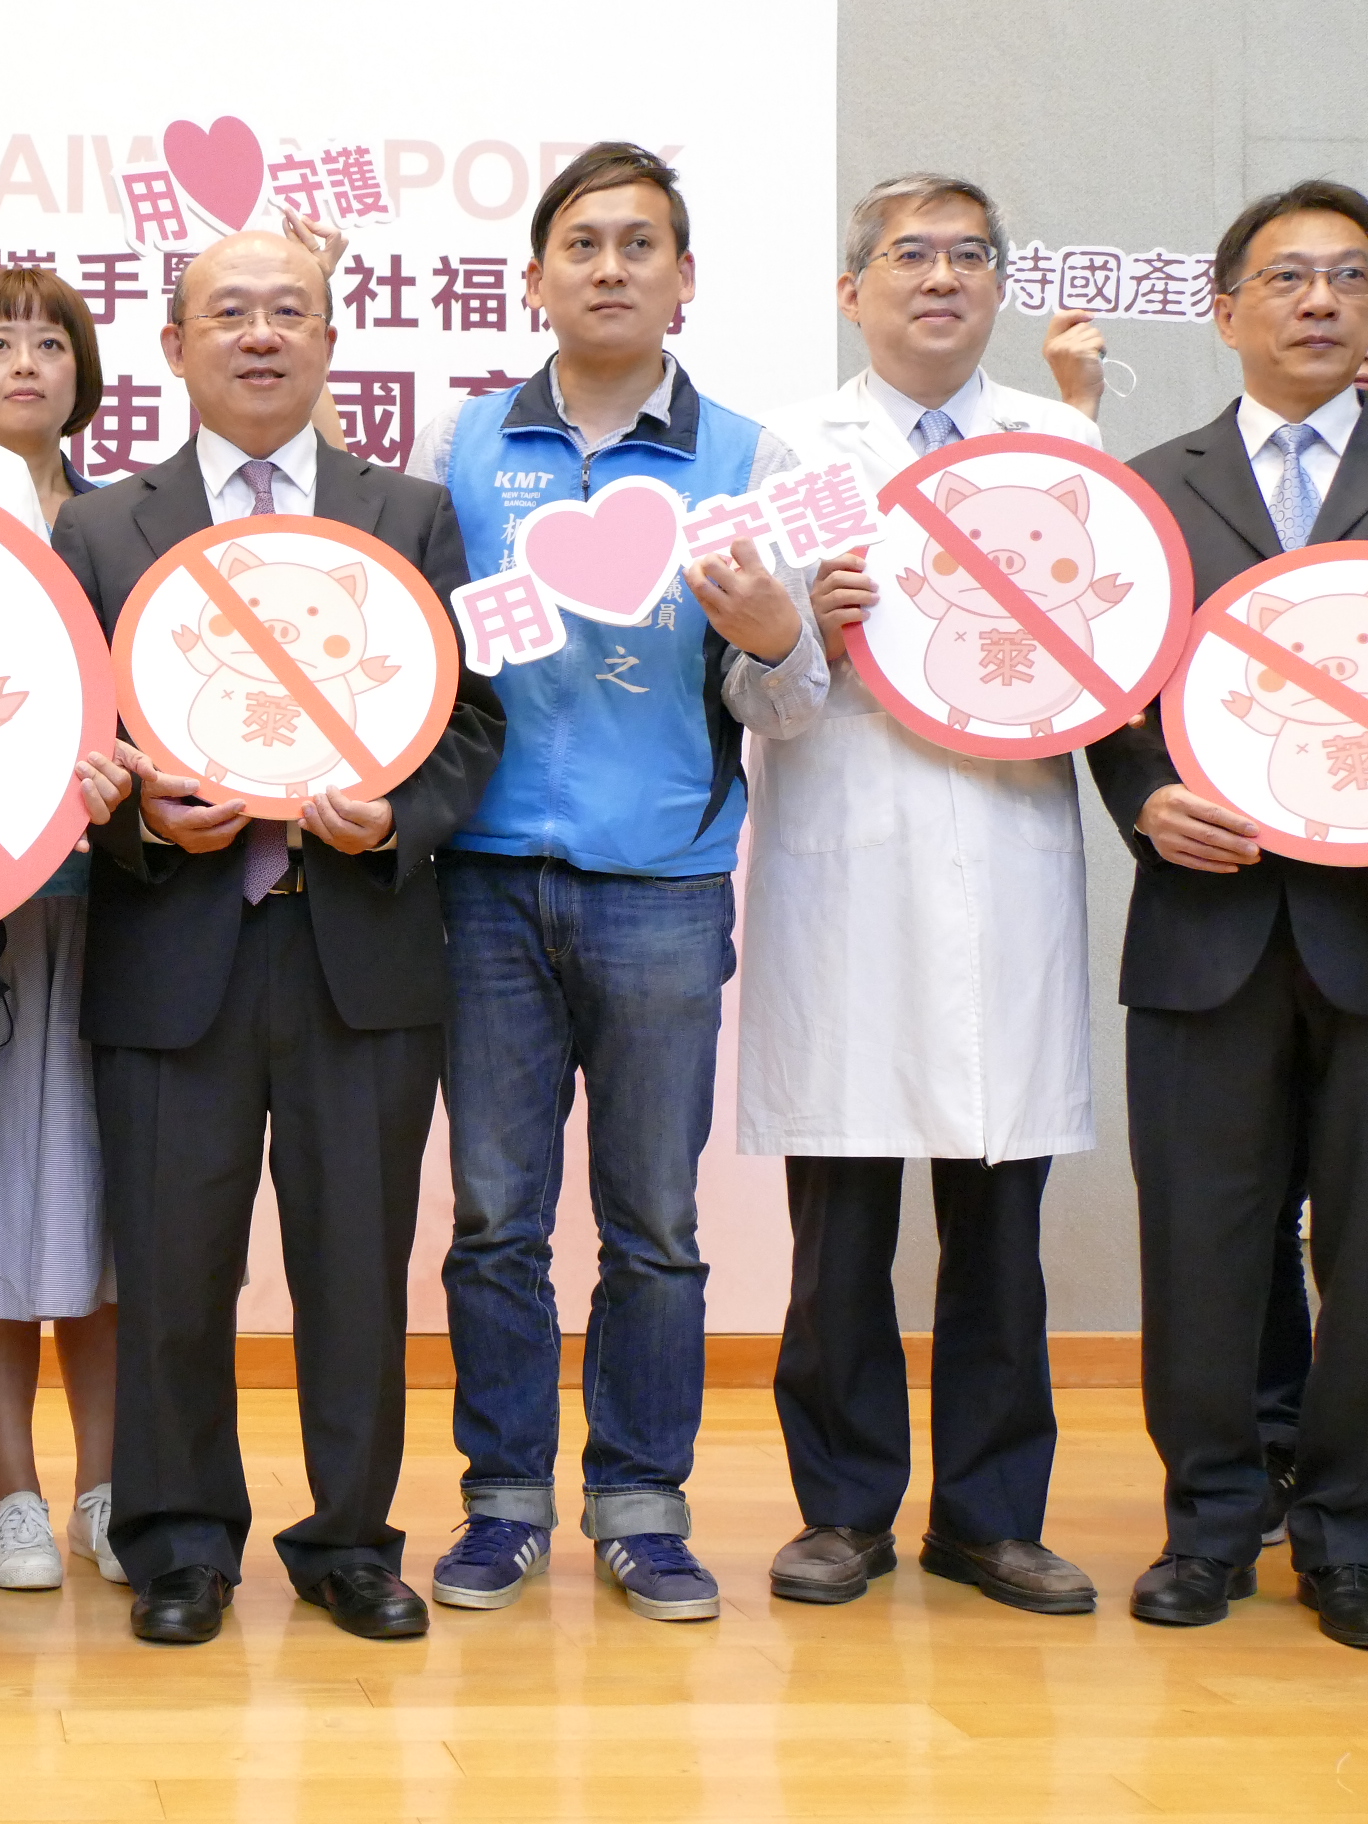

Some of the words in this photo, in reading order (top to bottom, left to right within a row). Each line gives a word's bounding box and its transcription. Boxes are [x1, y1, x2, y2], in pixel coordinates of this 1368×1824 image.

[122, 170, 188, 245] 用
[267, 145, 389, 222] 守護
[385, 139, 685, 220] PO
[494, 470, 554, 489] KMT
[519, 491, 541, 499] TAIPEI
[462, 573, 555, 665] 用
[978, 628, 1037, 686] 萊
[241, 691, 301, 747] 萊
